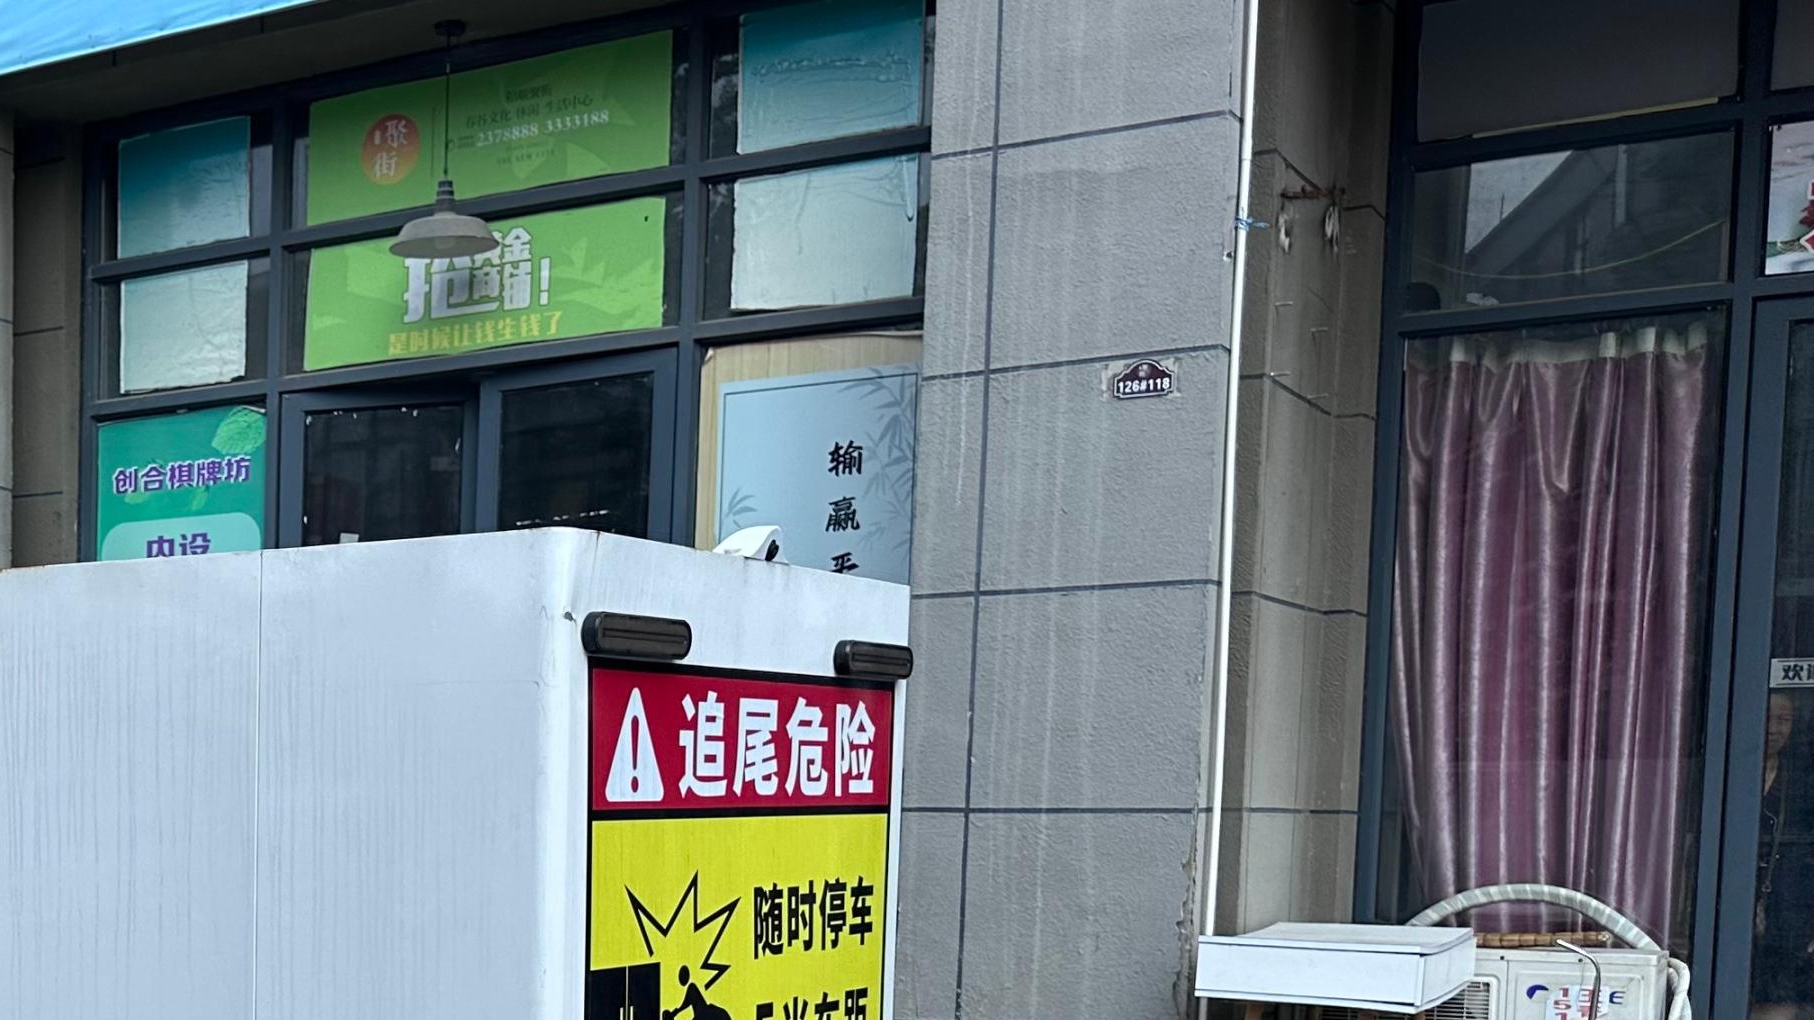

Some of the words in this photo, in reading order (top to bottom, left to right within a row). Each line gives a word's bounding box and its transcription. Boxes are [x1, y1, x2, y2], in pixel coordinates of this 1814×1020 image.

[1117, 377, 1170, 394] 126#118
[112, 455, 252, 495] 创合棋牌坊
[678, 690, 876, 799] 追尾危险
[753, 876, 875, 960] 随时停车
